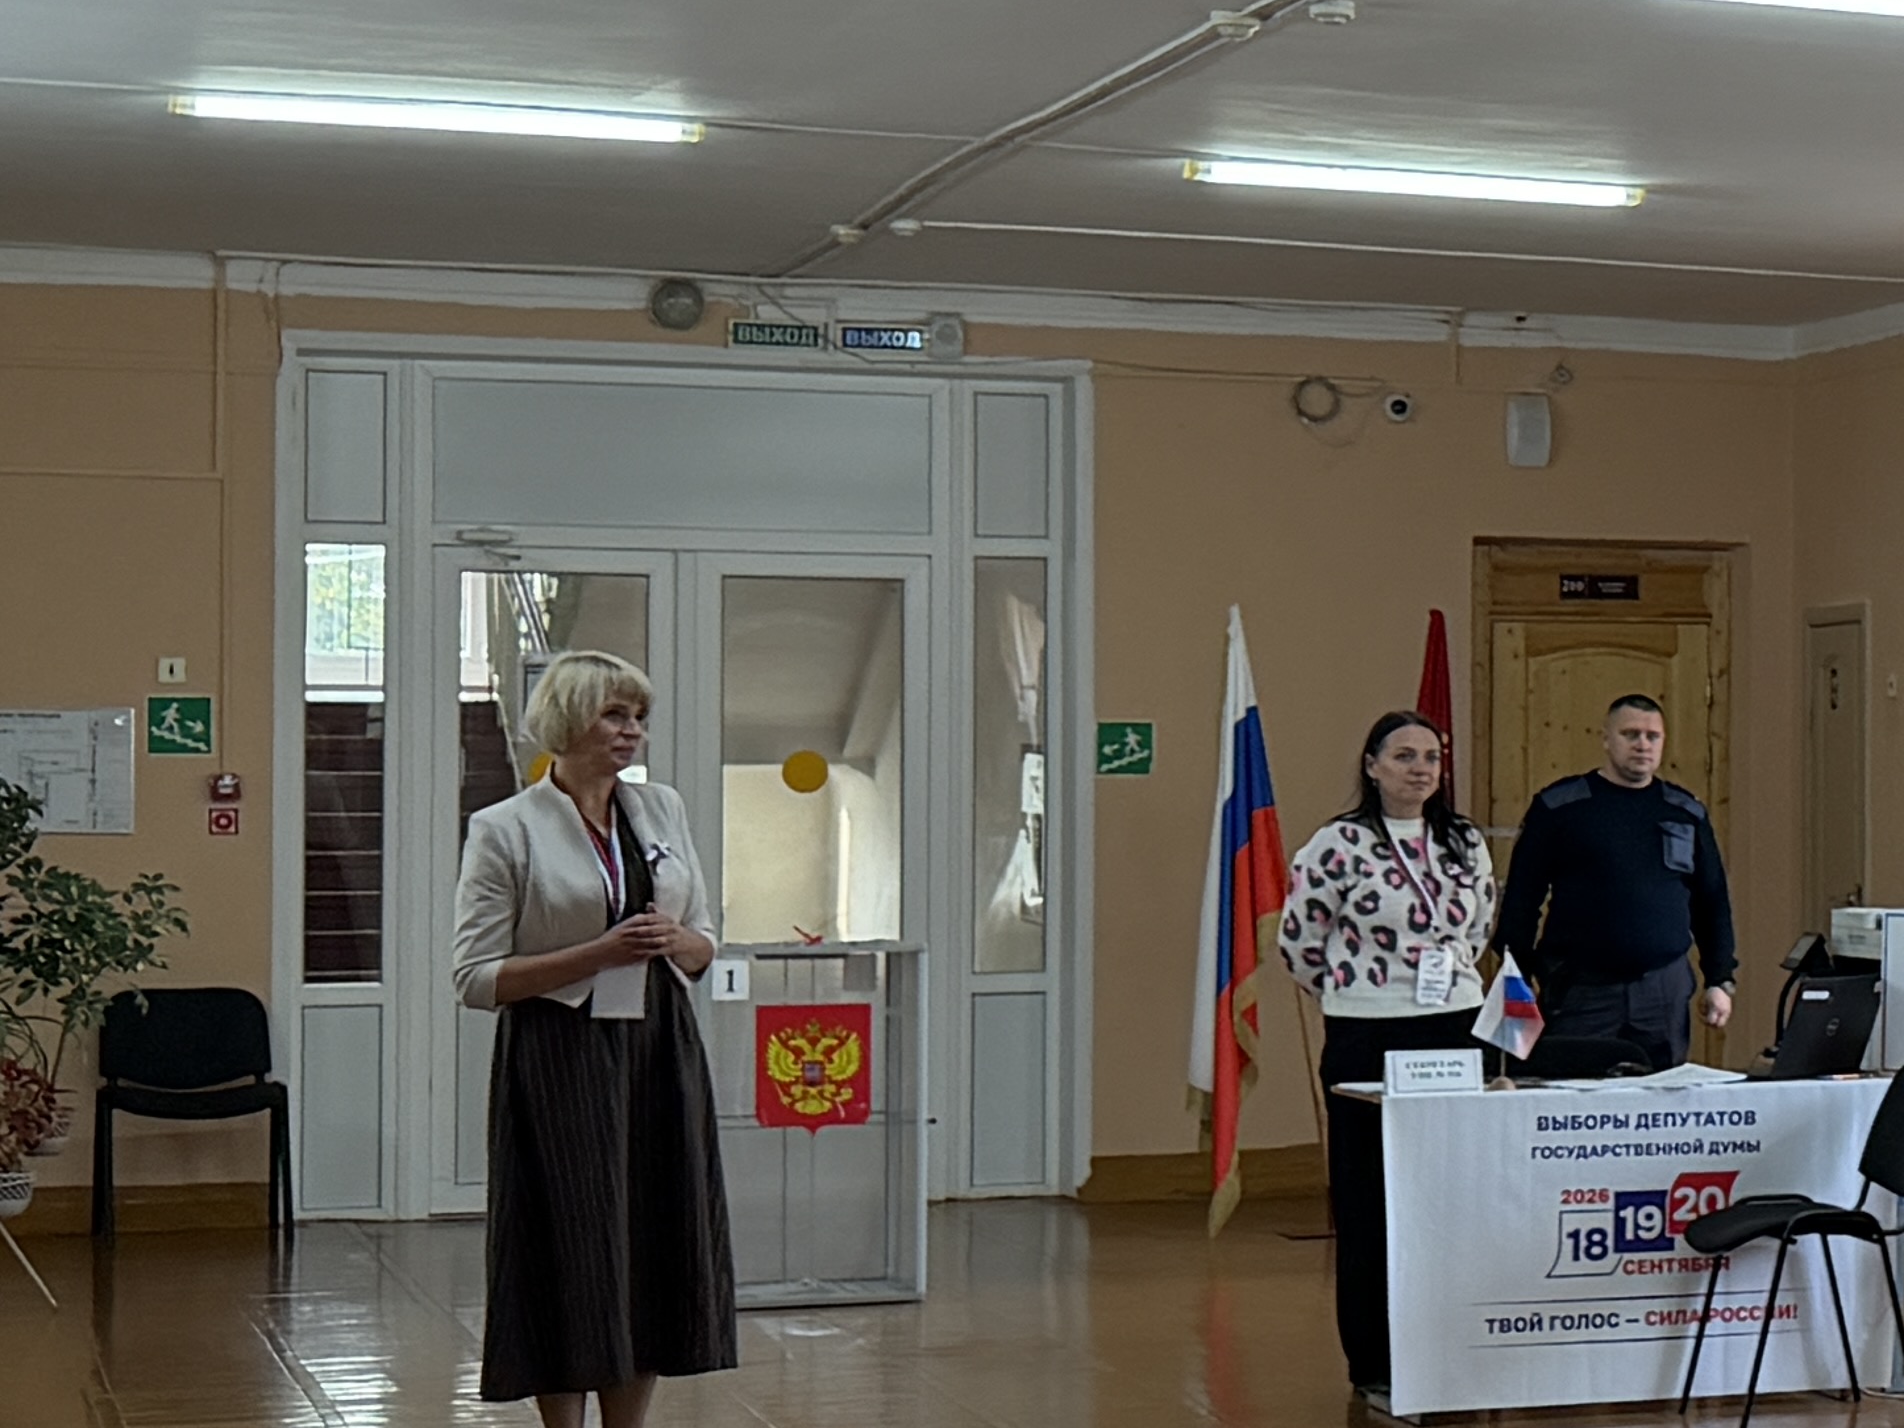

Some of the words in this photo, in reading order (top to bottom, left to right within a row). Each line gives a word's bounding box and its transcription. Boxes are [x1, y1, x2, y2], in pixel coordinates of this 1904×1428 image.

[737, 324, 816, 346] ВЫХОД
[845, 330, 922, 348] ВЫХОД
[726, 969, 735, 992] 1
[1536, 1113, 1630, 1132] ВЫБОРЫ
[1635, 1110, 1757, 1131] ДЕПУТАТОВ
[1531, 1139, 1704, 1160] ГОСУДАРСТВЕННОЙ
[1707, 1139, 1761, 1155] ДУМЫ
[1560, 1188, 1610, 1204] 2026
[1672, 1186, 1725, 1222] 20
[1618, 1205, 1664, 1240] 19
[1566, 1227, 1608, 1261] 18
[1485, 1311, 1543, 1335] ТВОЙ
[1549, 1312, 1620, 1332] ГОЛОС
[1644, 1308, 1703, 1327] СИЛА
[1707, 1303, 1798, 1324] РОССИ!
